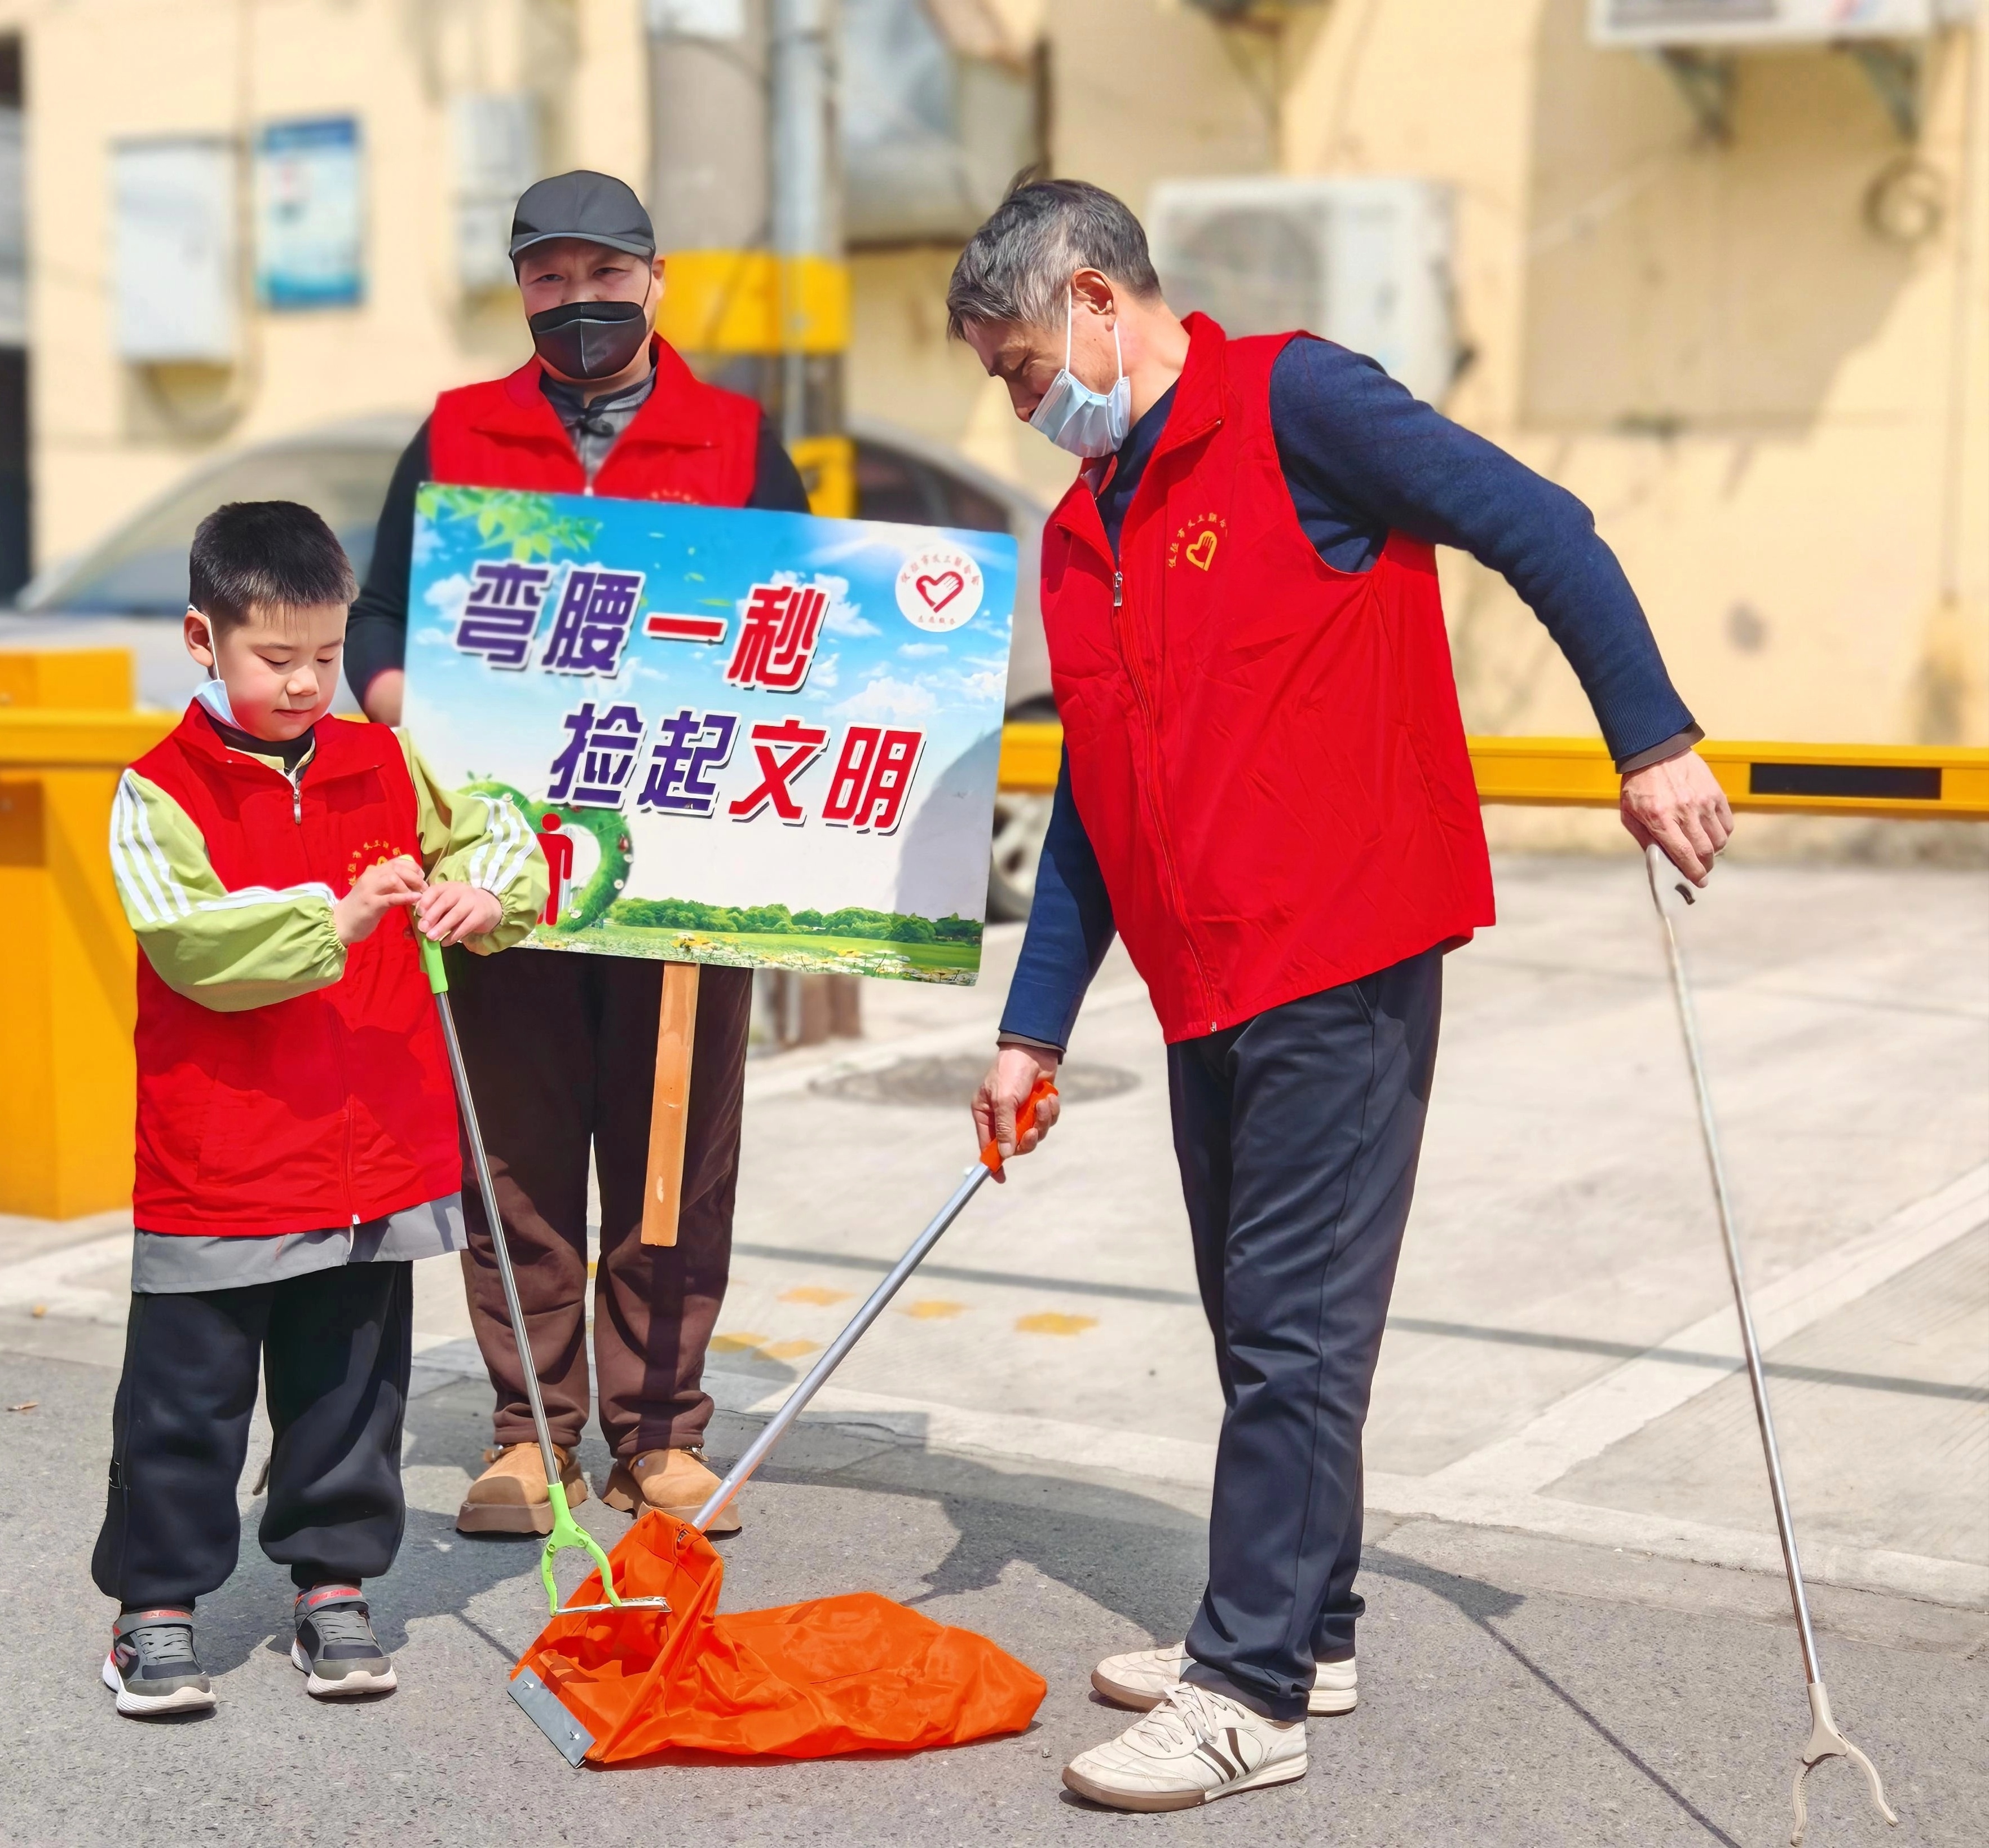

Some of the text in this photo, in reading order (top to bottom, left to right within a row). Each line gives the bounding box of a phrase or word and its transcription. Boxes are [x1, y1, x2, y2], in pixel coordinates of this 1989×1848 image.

[456, 563, 826, 687] 弯腰一秒
[546, 702, 923, 828] 捡起文明
